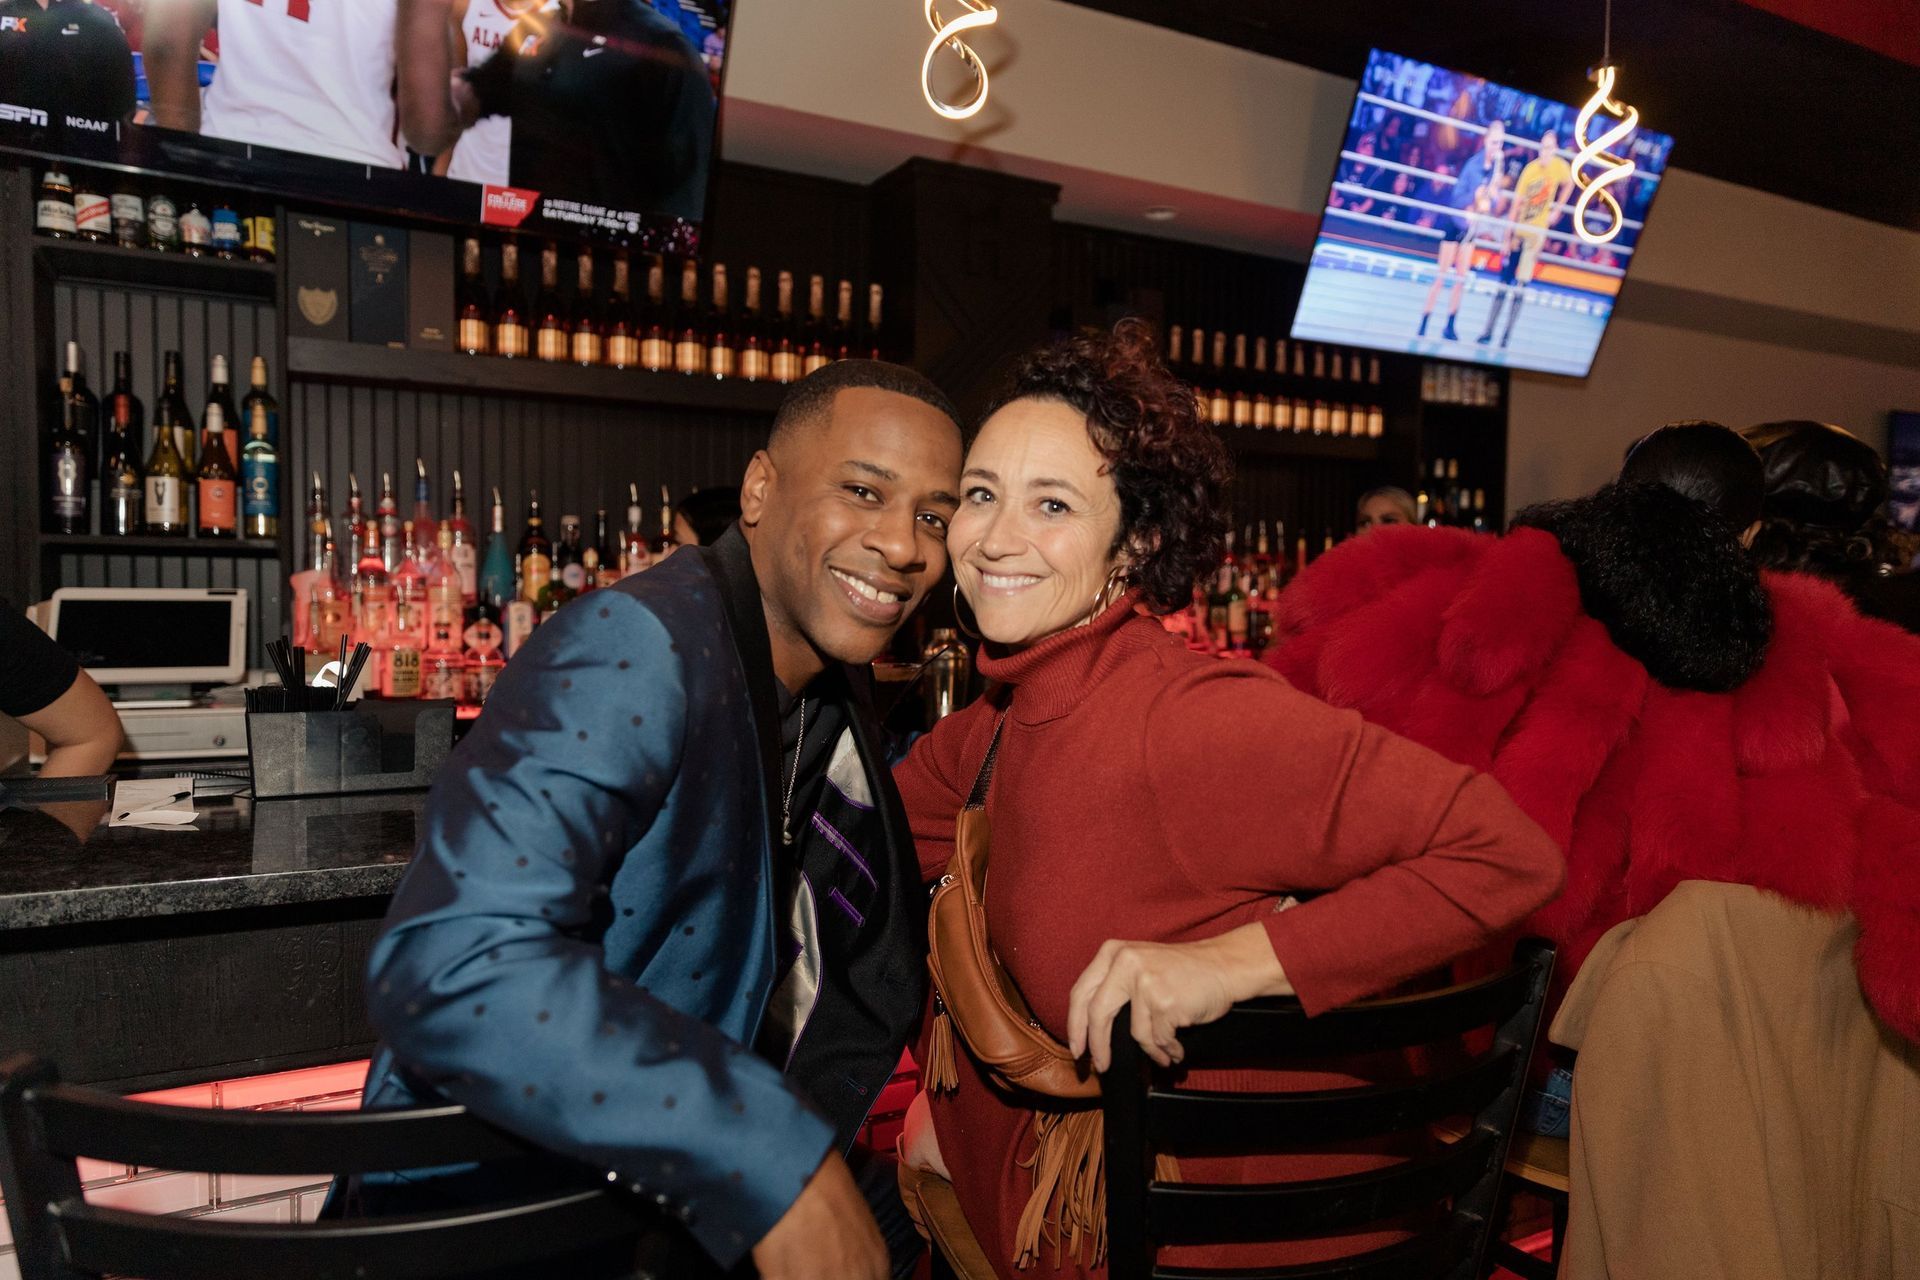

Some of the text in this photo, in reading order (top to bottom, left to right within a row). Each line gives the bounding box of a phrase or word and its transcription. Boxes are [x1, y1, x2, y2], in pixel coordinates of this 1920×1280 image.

[0, 102, 48, 127] SPN
[65, 115, 109, 132] NCAAF
[542, 207, 596, 225] SATURDAY
[393, 651, 419, 668] 818
